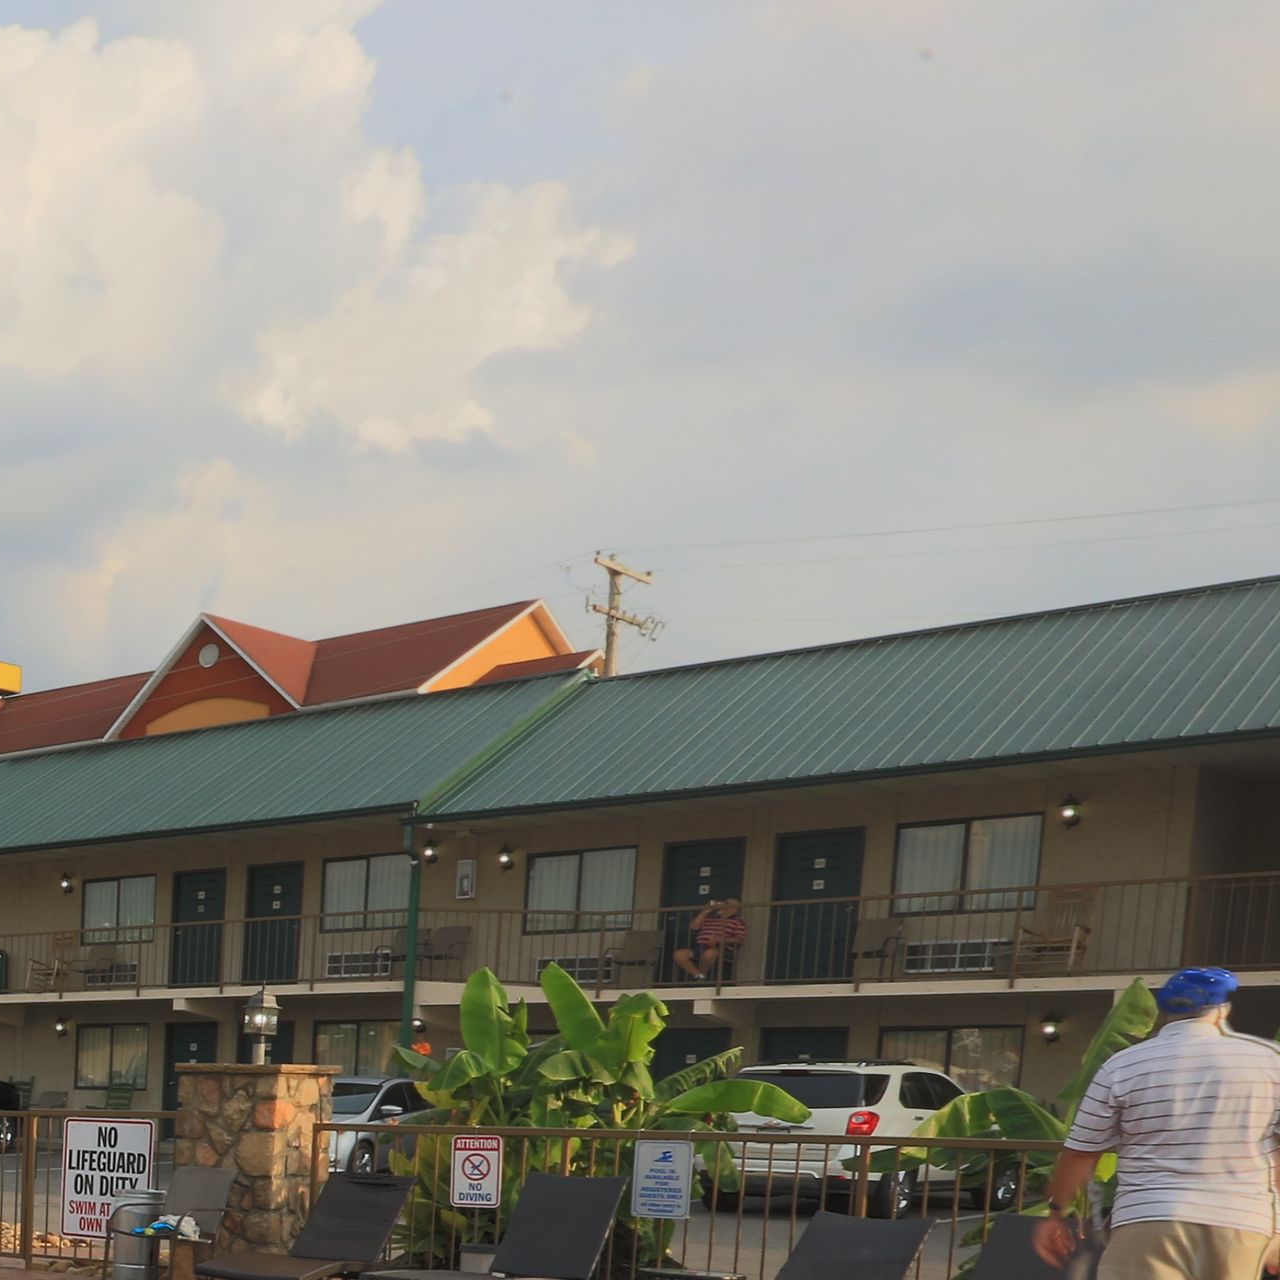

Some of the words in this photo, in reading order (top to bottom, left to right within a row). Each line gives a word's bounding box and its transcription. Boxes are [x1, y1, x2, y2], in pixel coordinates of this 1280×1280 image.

[97, 1126, 118, 1148] NO
[456, 1139, 498, 1149] ATTENTION
[68, 1149, 147, 1174] LIFEGUARD
[74, 1173, 94, 1195] ON
[99, 1175, 138, 1197] DUTY
[468, 1183, 483, 1192] NO
[458, 1192, 493, 1202] DIVING
[69, 1200, 96, 1216] SWIM
[100, 1203, 112, 1217] AT
[79, 1217, 102, 1232] OWN
